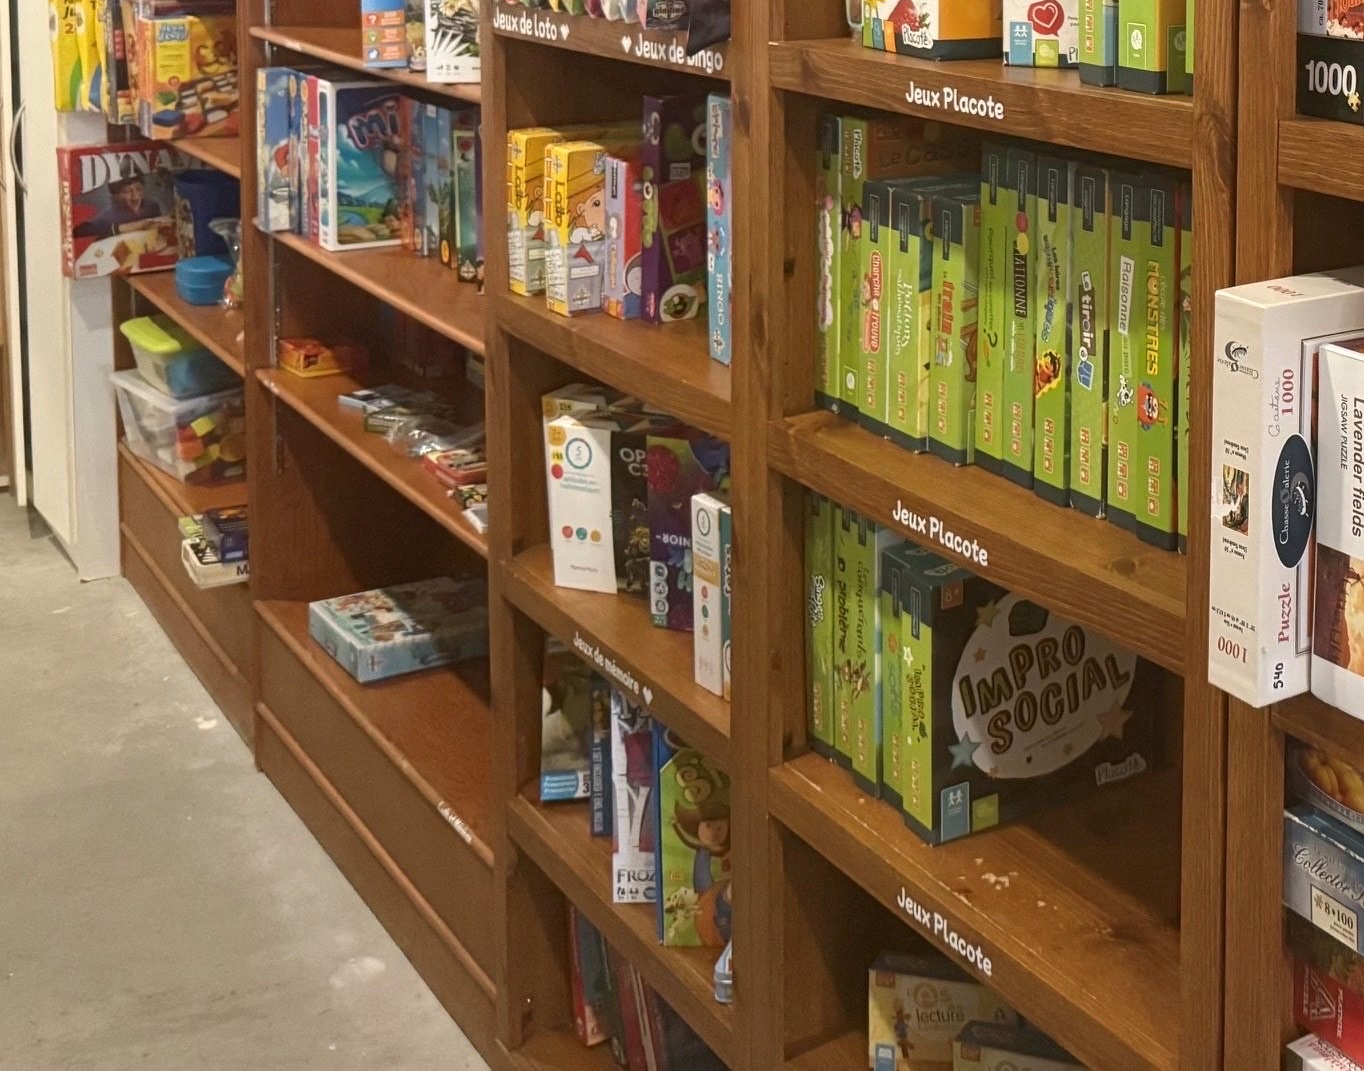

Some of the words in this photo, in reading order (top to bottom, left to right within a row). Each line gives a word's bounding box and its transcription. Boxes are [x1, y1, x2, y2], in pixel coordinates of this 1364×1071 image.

[493, 10, 519, 35] Jeux
[520, 17, 532, 37] de
[534, 17, 558, 42] loto
[635, 32, 666, 61] Jeux
[668, 38, 685, 64] de
[906, 81, 940, 111] Jeux
[943, 86, 1004, 120] Placote
[1305, 60, 1357, 98] 1000
[1081, 294, 1092, 349] tiroir
[1120, 261, 1131, 332] Raisonne
[1147, 261, 1160, 376] MONSTRES
[1282, 369, 1294, 415] 1000
[1340, 393, 1349, 431] JIGSAW
[1340, 432, 1349, 471] PUZZLE
[892, 499, 928, 535] Jeux
[930, 515, 988, 567] Placote
[1353, 487, 1364, 537] fields
[1278, 583, 1291, 644] Puzzle
[573, 632, 593, 657] Jeux
[593, 650, 605, 667] de
[605, 658, 640, 695] mémoire
[958, 625, 1086, 719] IMPRO
[1217, 635, 1248, 664] 1000
[1273, 662, 1284, 689] 540
[987, 653, 1130, 755] SOCIAL
[1293, 842, 1350, 893] Collector
[897, 886, 932, 927] Jeux
[934, 913, 993, 978] Placote
